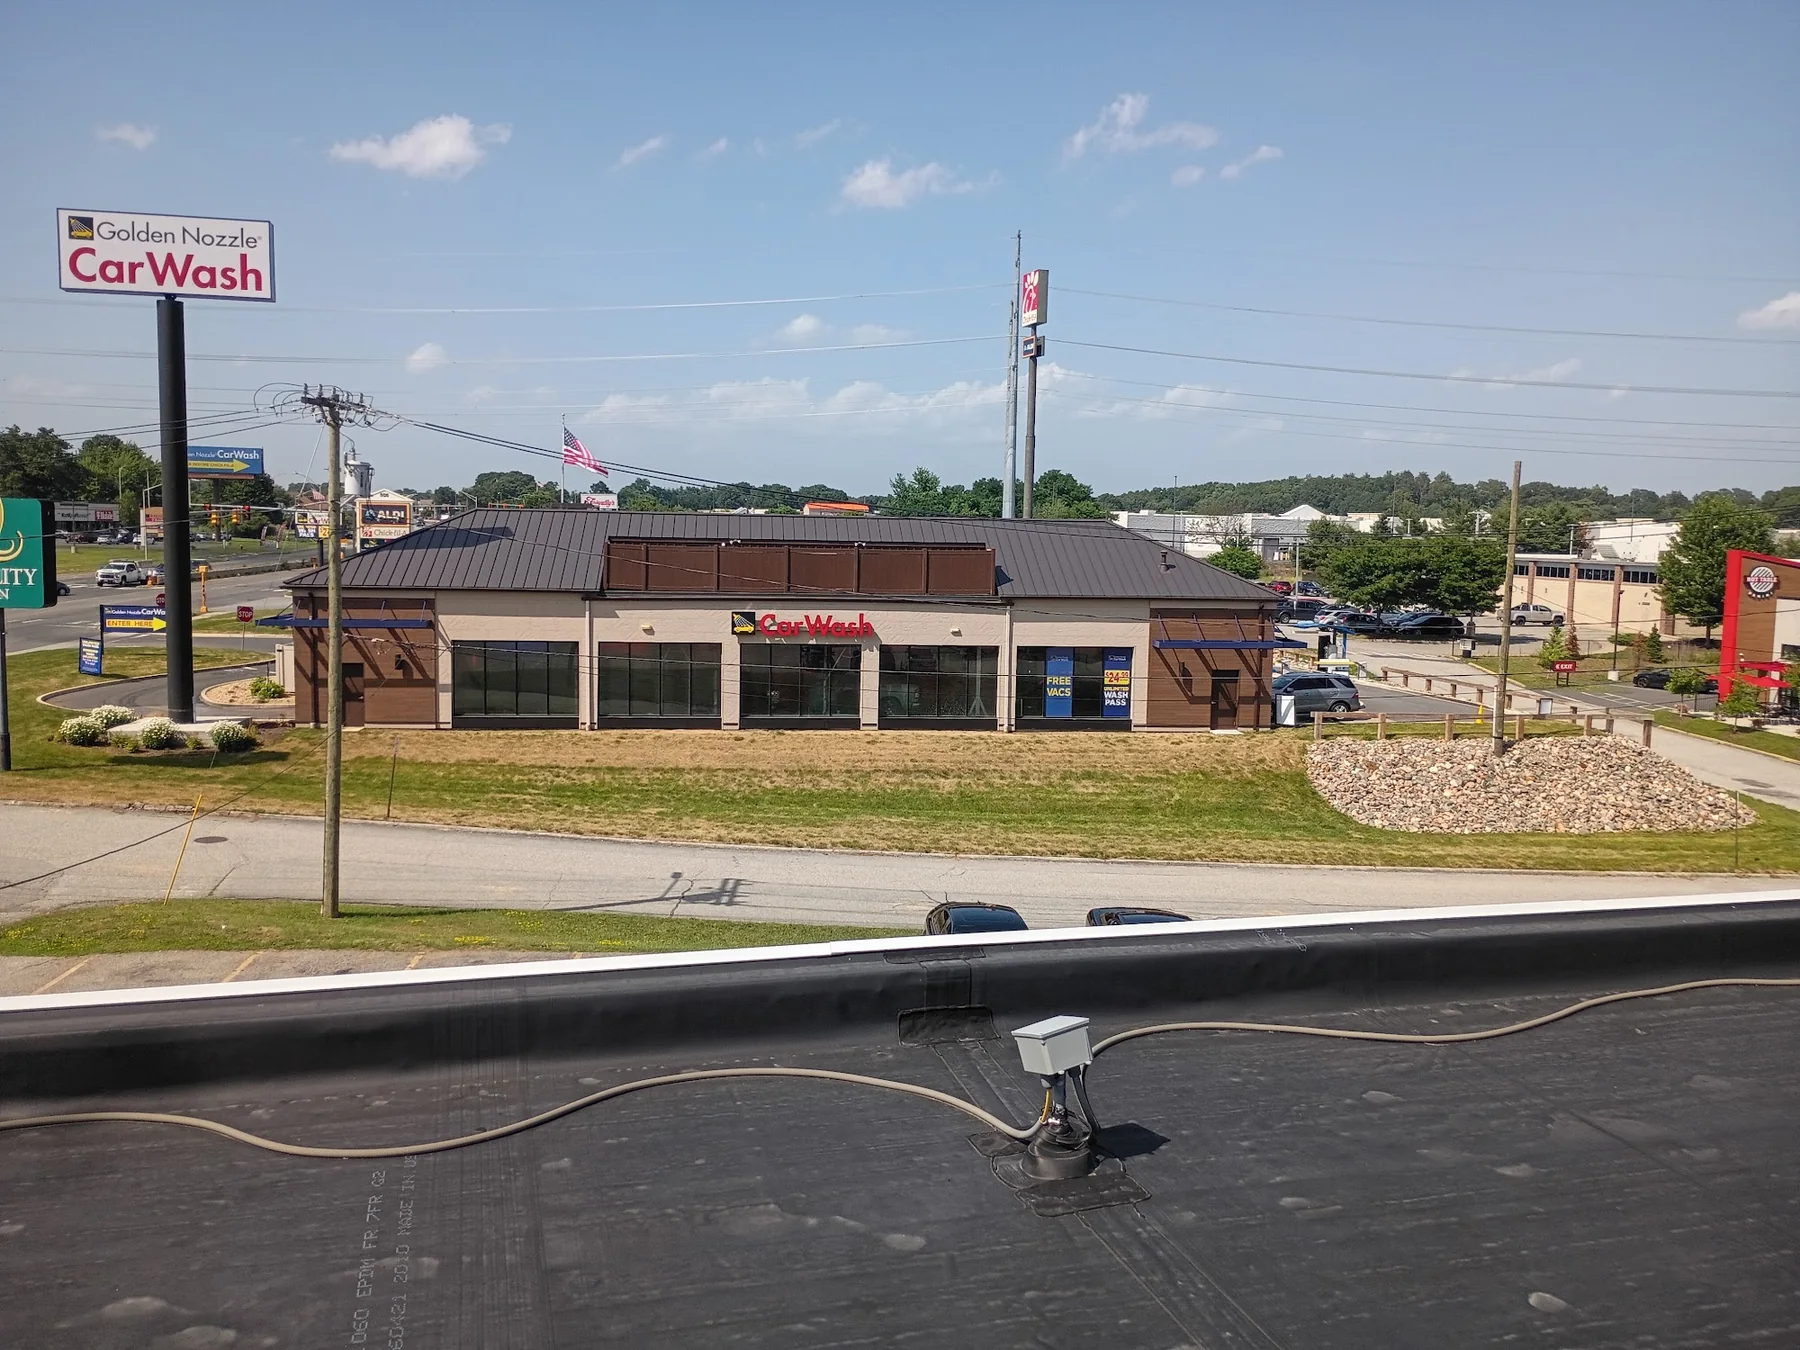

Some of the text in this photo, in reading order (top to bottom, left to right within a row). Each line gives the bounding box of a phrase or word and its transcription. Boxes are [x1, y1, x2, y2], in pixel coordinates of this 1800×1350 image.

[96, 221, 175, 244] Golden
[68, 247, 263, 291] CarWash
[217, 450, 260, 460] CarWash
[378, 510, 404, 518] ALDI
[1046, 676, 1072, 685] FREE
[1046, 688, 1071, 696] VACS
[404, 1155, 417, 1168] US
[371, 1170, 386, 1187] G2
[362, 1230, 378, 1249] FR
[356, 1258, 376, 1298] EPDM
